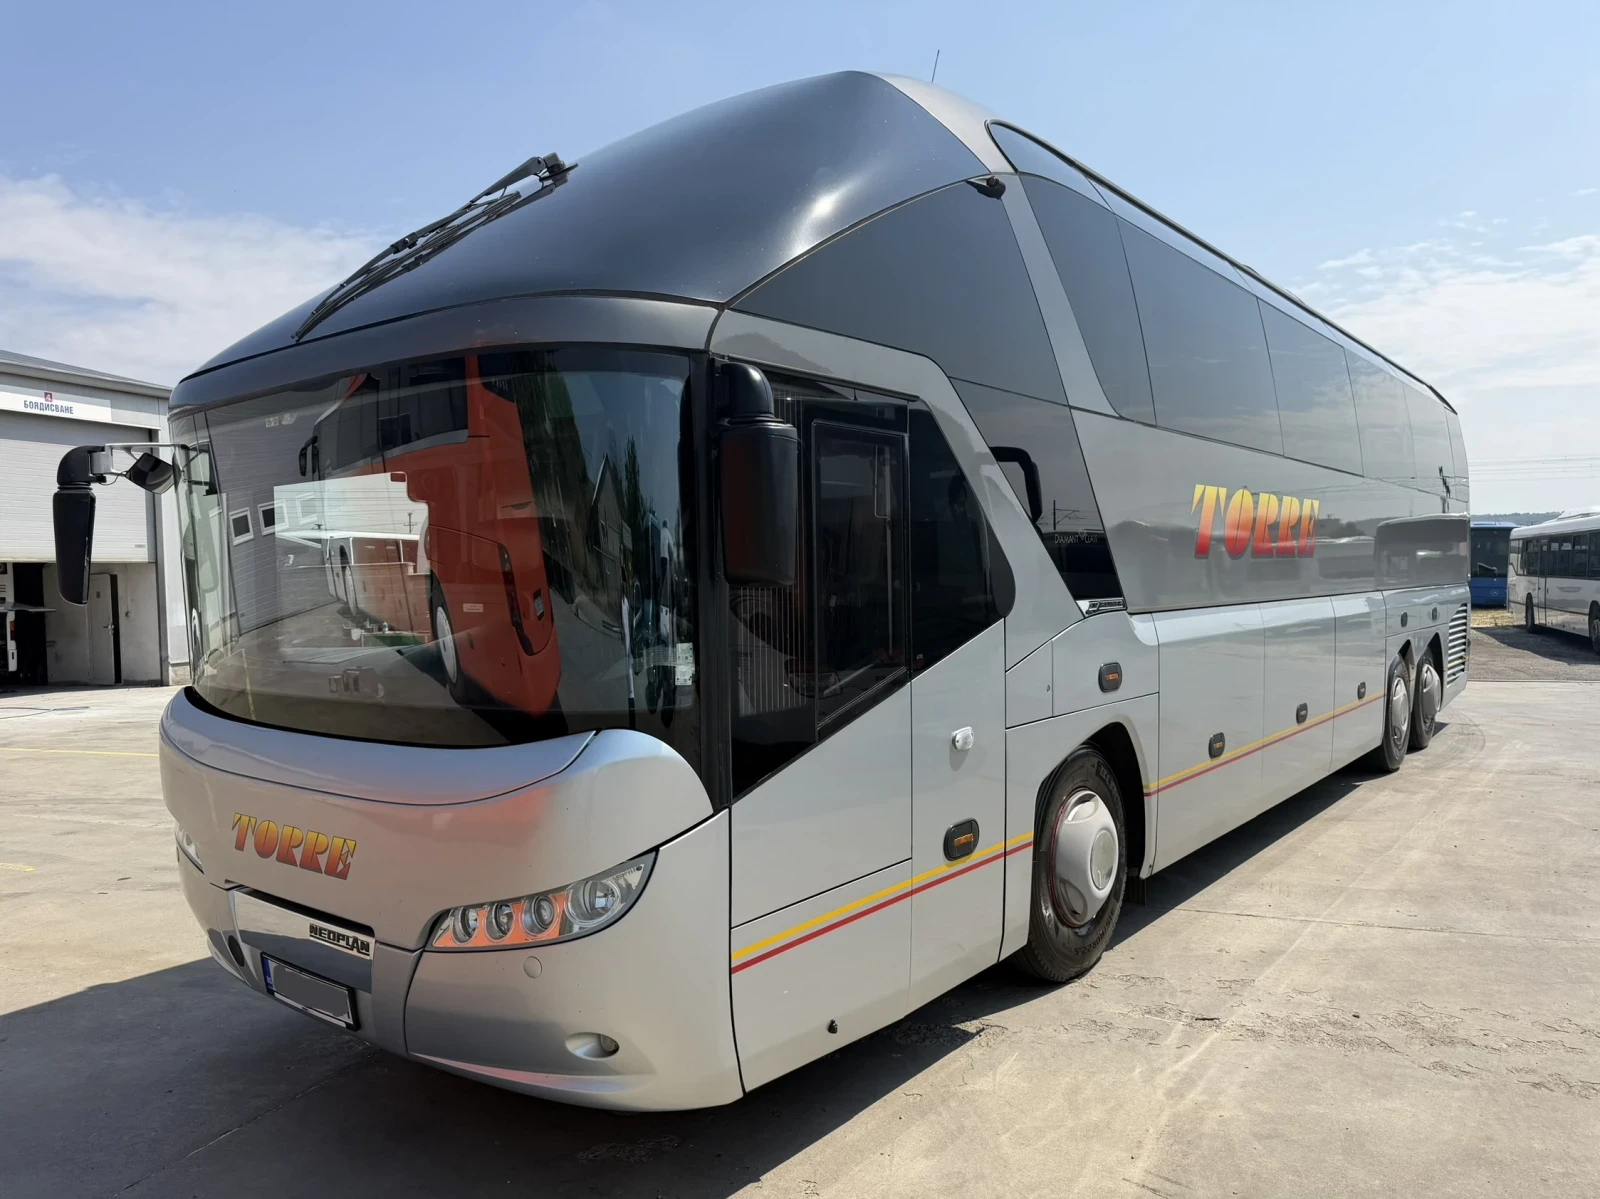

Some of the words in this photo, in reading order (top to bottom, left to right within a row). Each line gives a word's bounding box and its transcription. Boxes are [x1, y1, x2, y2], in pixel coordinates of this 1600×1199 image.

[23, 400, 74, 414] БОЯДИСВАНЕ
[1191, 484, 1320, 559] TORRE
[232, 812, 357, 880] TORRE
[309, 923, 370, 956] NEOPLAN
